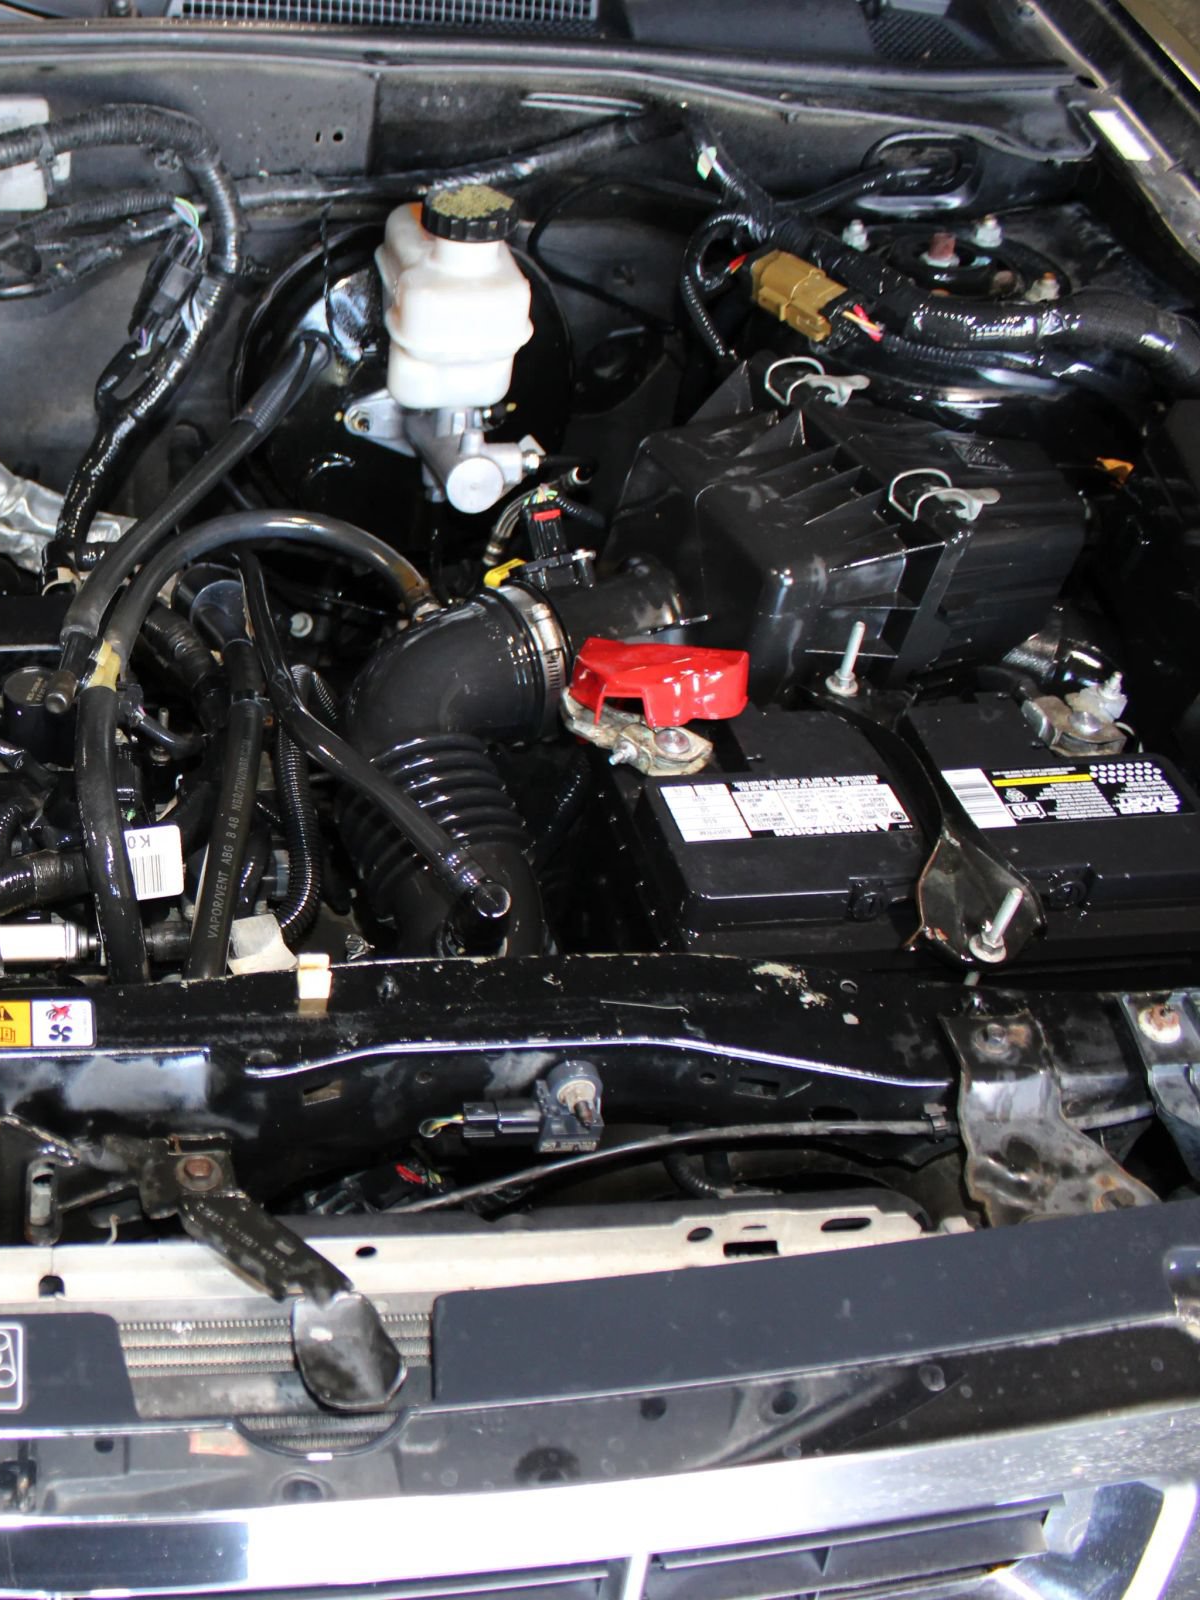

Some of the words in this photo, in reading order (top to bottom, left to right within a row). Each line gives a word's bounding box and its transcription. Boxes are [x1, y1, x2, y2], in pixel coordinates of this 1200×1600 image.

[1120, 795, 1181, 806] START
[1119, 804, 1179, 815] SUPER
[773, 823, 878, 837] DANGER/POISON
[208, 870, 230, 940] VAPOR/VENT
